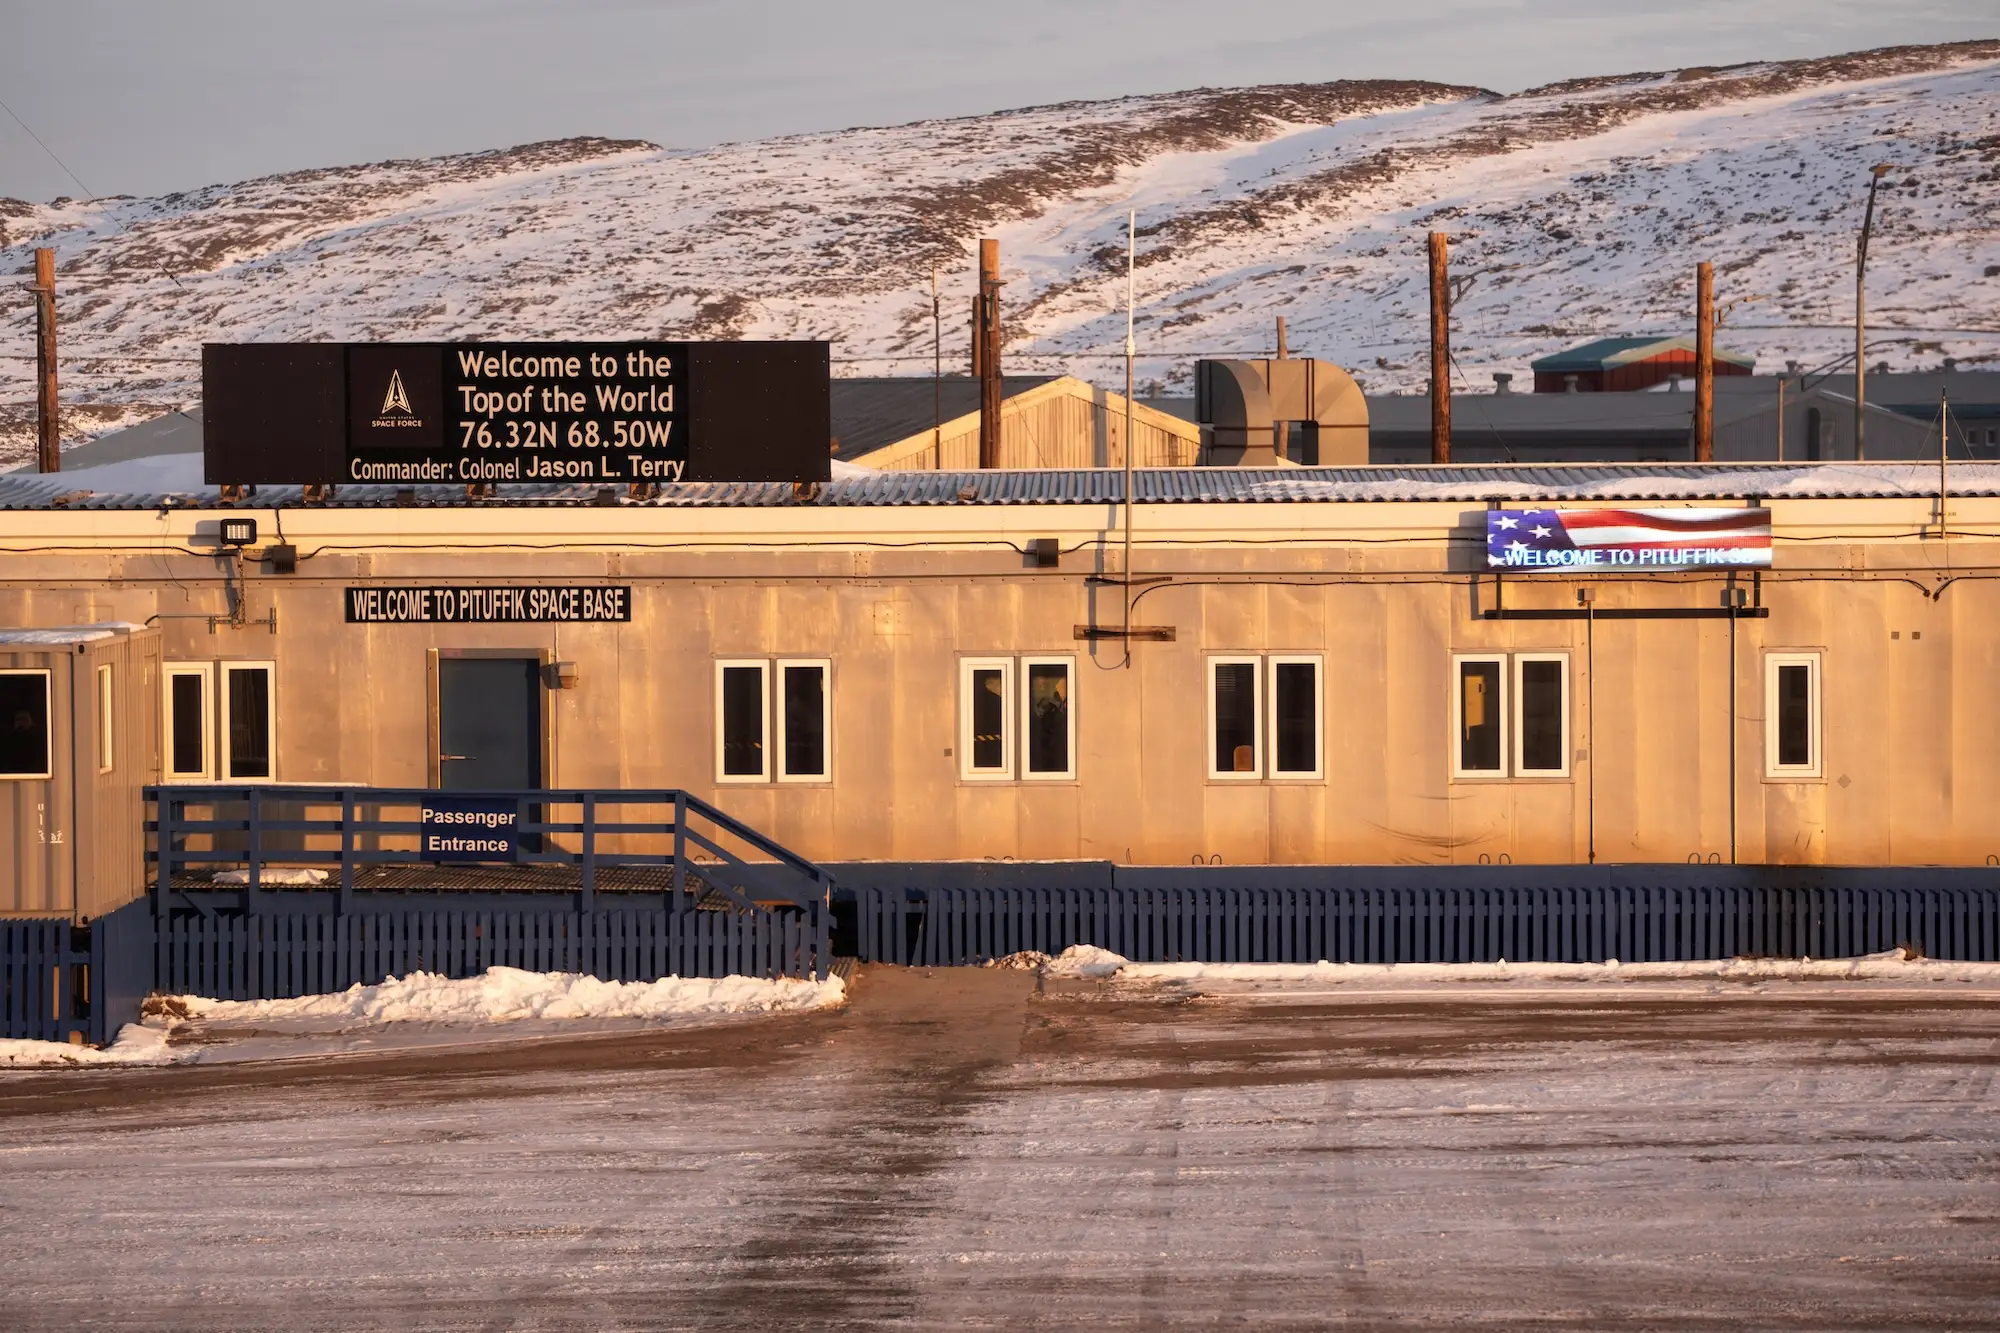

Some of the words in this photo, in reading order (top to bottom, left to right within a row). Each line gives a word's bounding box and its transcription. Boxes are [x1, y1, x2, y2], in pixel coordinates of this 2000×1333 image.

[458, 350, 581, 378] Welcome
[590, 352, 618, 378] to
[626, 350, 672, 378] the
[542, 385, 587, 413] the
[595, 384, 674, 413] World
[371, 420, 396, 428] SPACE
[397, 420, 422, 428] FORCE
[459, 420, 558, 449] 76.32N
[567, 420, 673, 449] 68.50W
[351, 457, 453, 480] Commander:
[459, 457, 520, 480] Colonel
[526, 455, 594, 478] Jason
[601, 455, 621, 477] L.
[627, 454, 685, 482] Terry
[1504, 549, 1603, 566] WELCOME
[1607, 549, 1635, 565] TO
[1639, 548, 1725, 565] PITUFFIK
[353, 589, 431, 621] WELCOME
[434, 589, 455, 620] TO
[460, 589, 526, 620] PITUFFIK
[529, 589, 580, 620] SPACE
[583, 588, 624, 619] BASE
[422, 808, 517, 828] Passenger
[429, 835, 509, 852] Entrance
